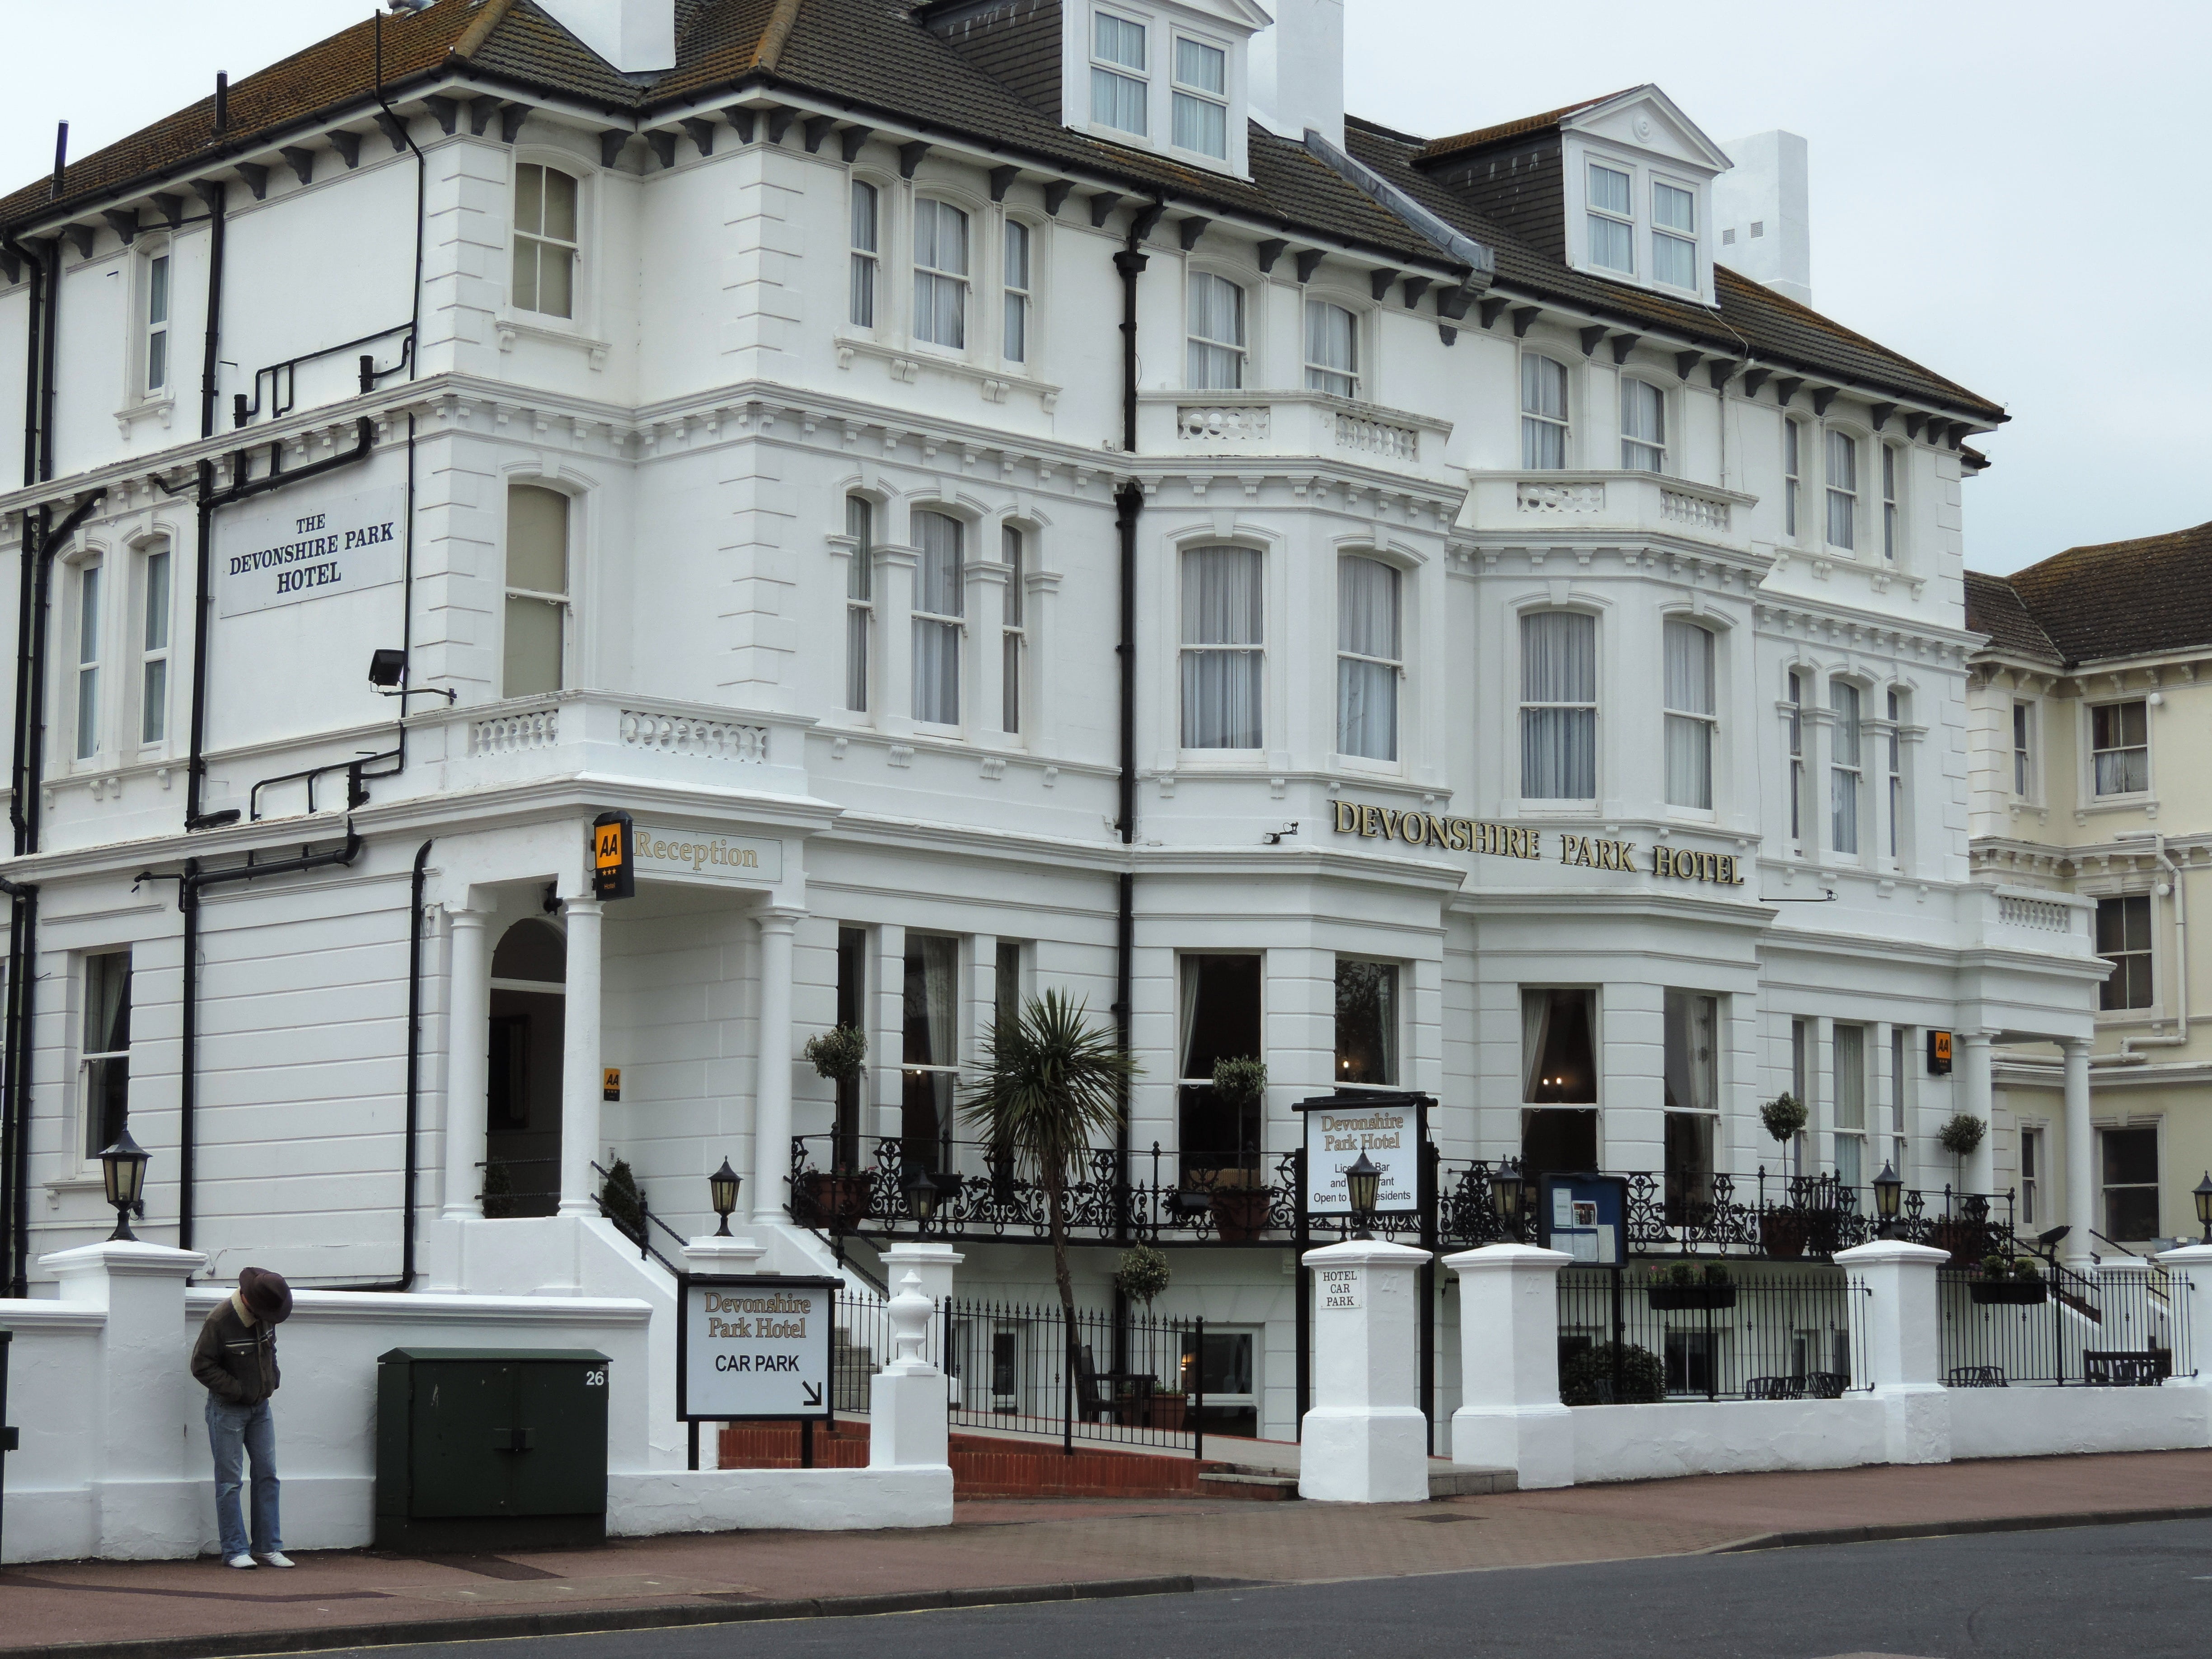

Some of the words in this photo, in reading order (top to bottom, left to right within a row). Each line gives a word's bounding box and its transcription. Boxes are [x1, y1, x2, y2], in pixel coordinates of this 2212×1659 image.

[296, 513, 326, 534] THE
[230, 534, 338, 576] DEVONSHIRE
[345, 522, 394, 550] PARK
[276, 562, 342, 594] HOTEL
[600, 834, 618, 858] AA
[633, 831, 759, 871] Reception
[1332, 799, 1541, 861] DEVONSHIRE
[1560, 834, 1637, 872] PARK
[1653, 845, 1745, 886] HOTEL
[1938, 1039, 1949, 1053] AA
[606, 1074, 619, 1085] AA
[1321, 1113, 1404, 1132] Devonshire
[1325, 1134, 1358, 1151] Park
[1360, 1132, 1400, 1149] Hotel
[1375, 1162, 1390, 1172] Bar
[1331, 1178, 1346, 1187] and
[1314, 1193, 1336, 1204] Open
[1339, 1193, 1347, 1202] to
[1323, 1271, 1357, 1281] HOTEL
[1330, 1284, 1350, 1293] CAR
[704, 1292, 811, 1314] Devonshire
[1326, 1296, 1354, 1306] PARK
[708, 1317, 752, 1337] Park
[755, 1317, 806, 1338] Hotel
[715, 1354, 751, 1372] CAR
[755, 1355, 800, 1372] PARK
[586, 1371, 604, 1386] 26
